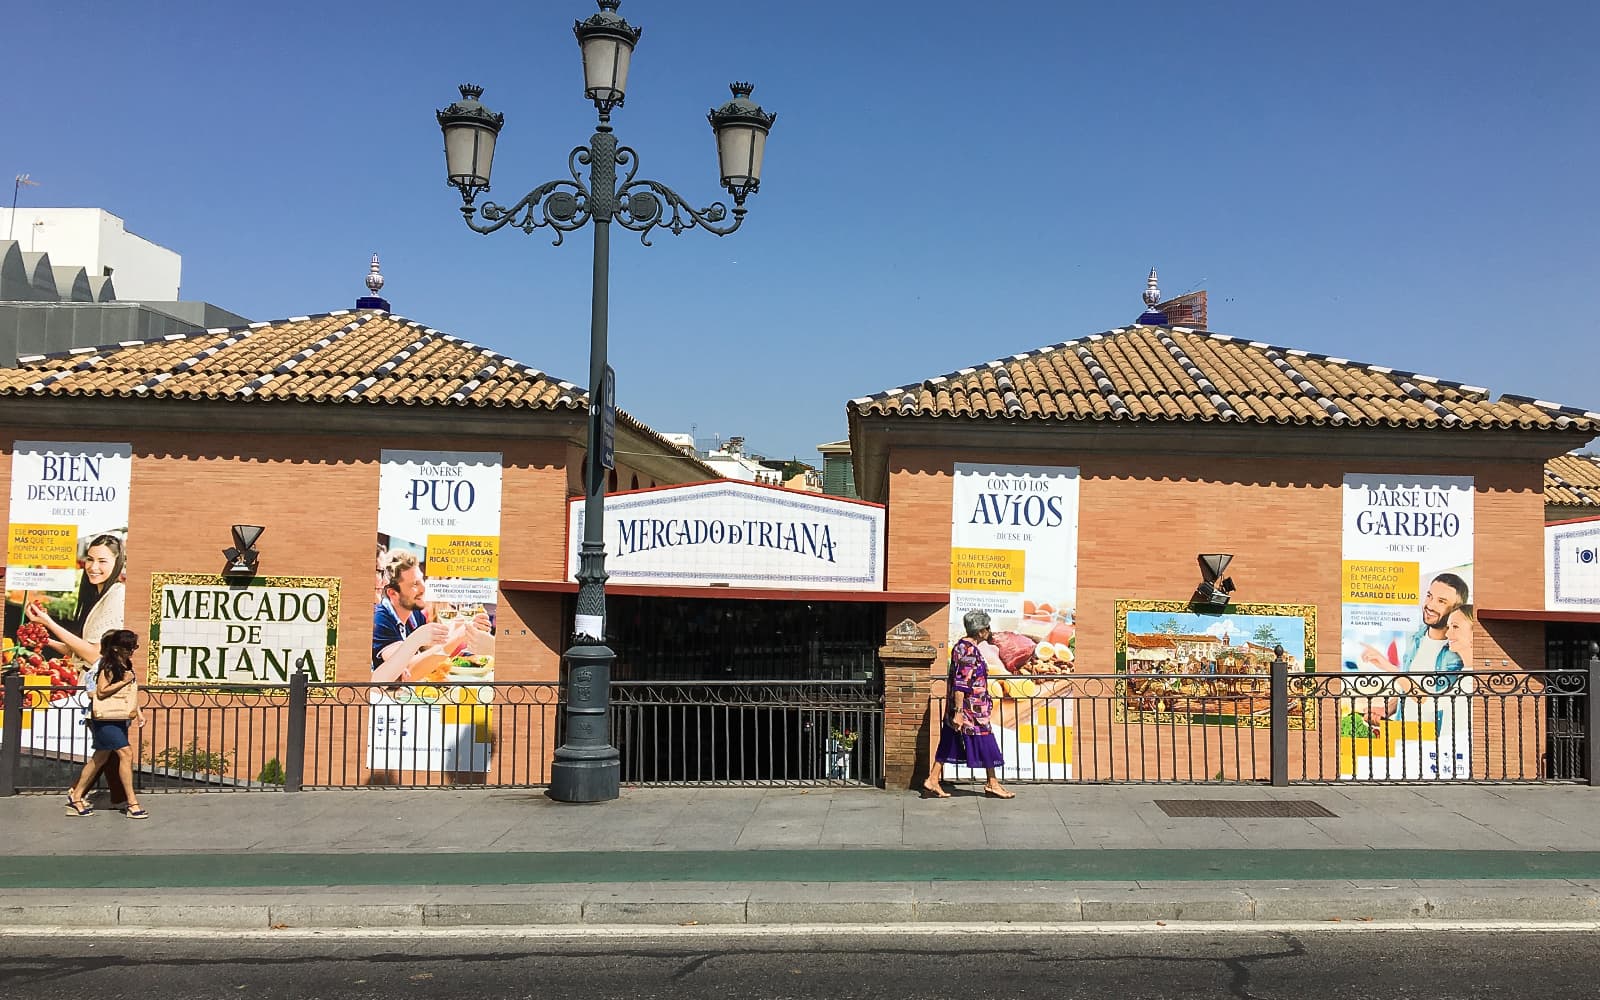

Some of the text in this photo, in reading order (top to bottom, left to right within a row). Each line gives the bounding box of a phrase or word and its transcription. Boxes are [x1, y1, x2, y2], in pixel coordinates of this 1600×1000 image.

[41, 456, 102, 482] BIEN
[420, 466, 463, 477] PONERSE
[27, 484, 116, 502] DESPACHAO
[987, 478, 1009, 491] CON
[1030, 480, 1049, 492] LOS
[1367, 490, 1450, 508] DARSE UN
[1356, 510, 1460, 538] GARBEO
[616, 518, 725, 558] MERCADO
[743, 519, 837, 563] TRIANA
[163, 589, 326, 622] MERCADO
[226, 624, 262, 644] DE
[161, 645, 322, 682] TRIANA
